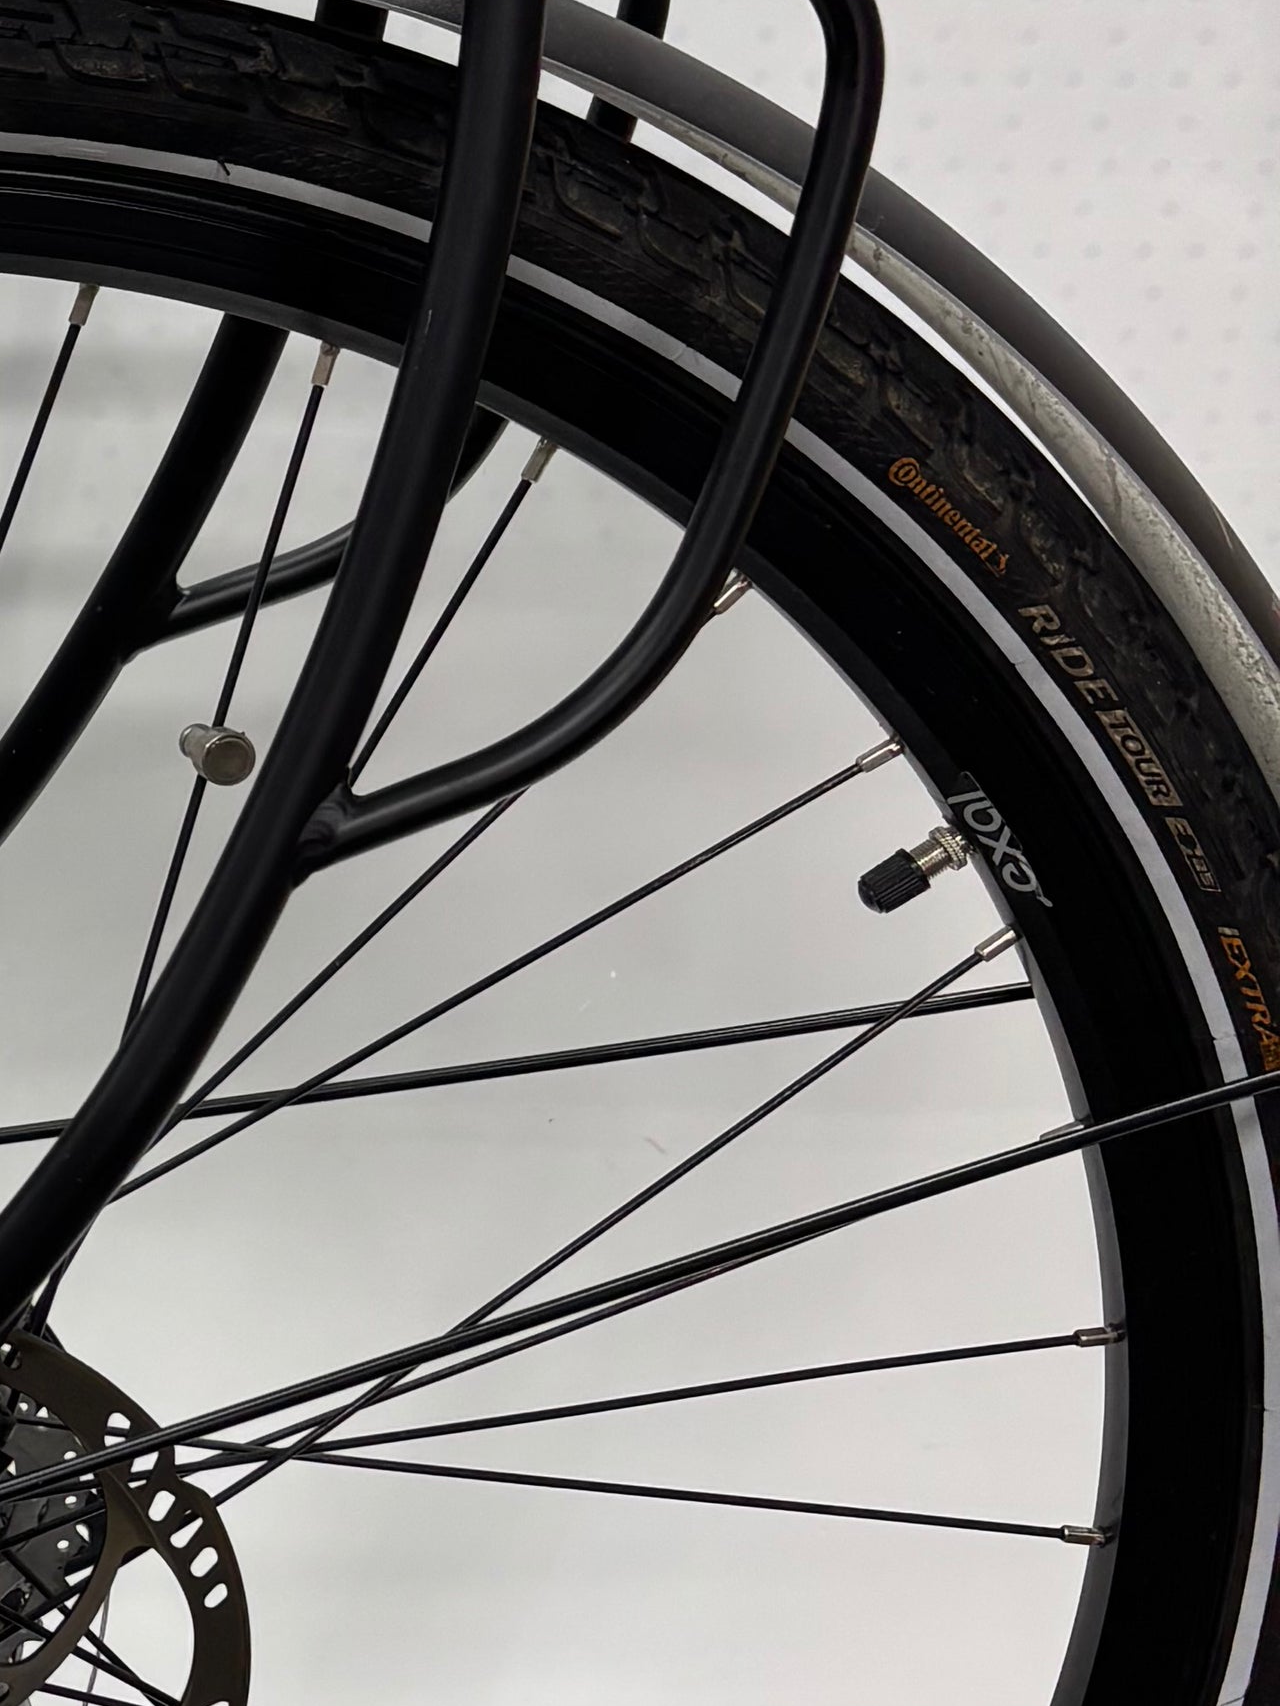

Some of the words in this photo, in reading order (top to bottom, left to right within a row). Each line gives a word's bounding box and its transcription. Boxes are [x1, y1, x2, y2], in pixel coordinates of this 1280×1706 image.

[888, 456, 997, 566] Continental
[1017, 604, 1119, 705] RIDE
[1103, 712, 1175, 802] TOUR
